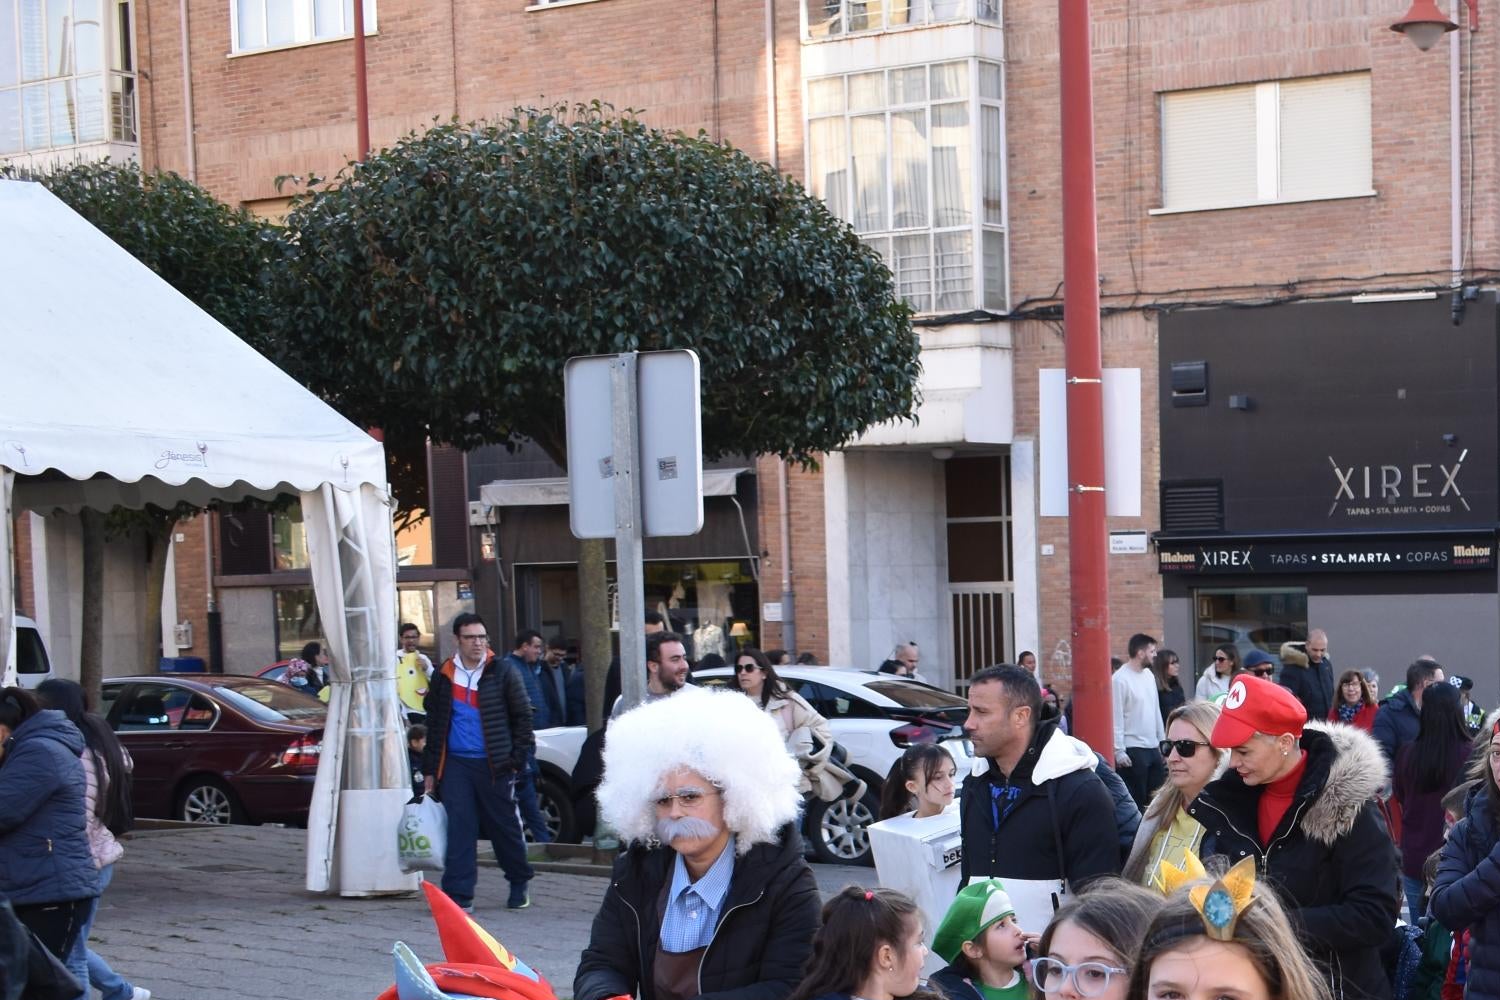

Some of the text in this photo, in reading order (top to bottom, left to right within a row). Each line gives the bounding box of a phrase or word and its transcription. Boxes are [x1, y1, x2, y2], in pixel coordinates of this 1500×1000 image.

[1332, 457, 1466, 505] XIREX
[1346, 507, 1371, 516] TAPAS
[1453, 545, 1491, 557] Mahou
[1160, 552, 1196, 563] Mahou
[1201, 548, 1252, 569] XIREX
[1270, 554, 1308, 564] TAPAS
[1406, 552, 1448, 562] COPAS
[1229, 689, 1240, 703] M
